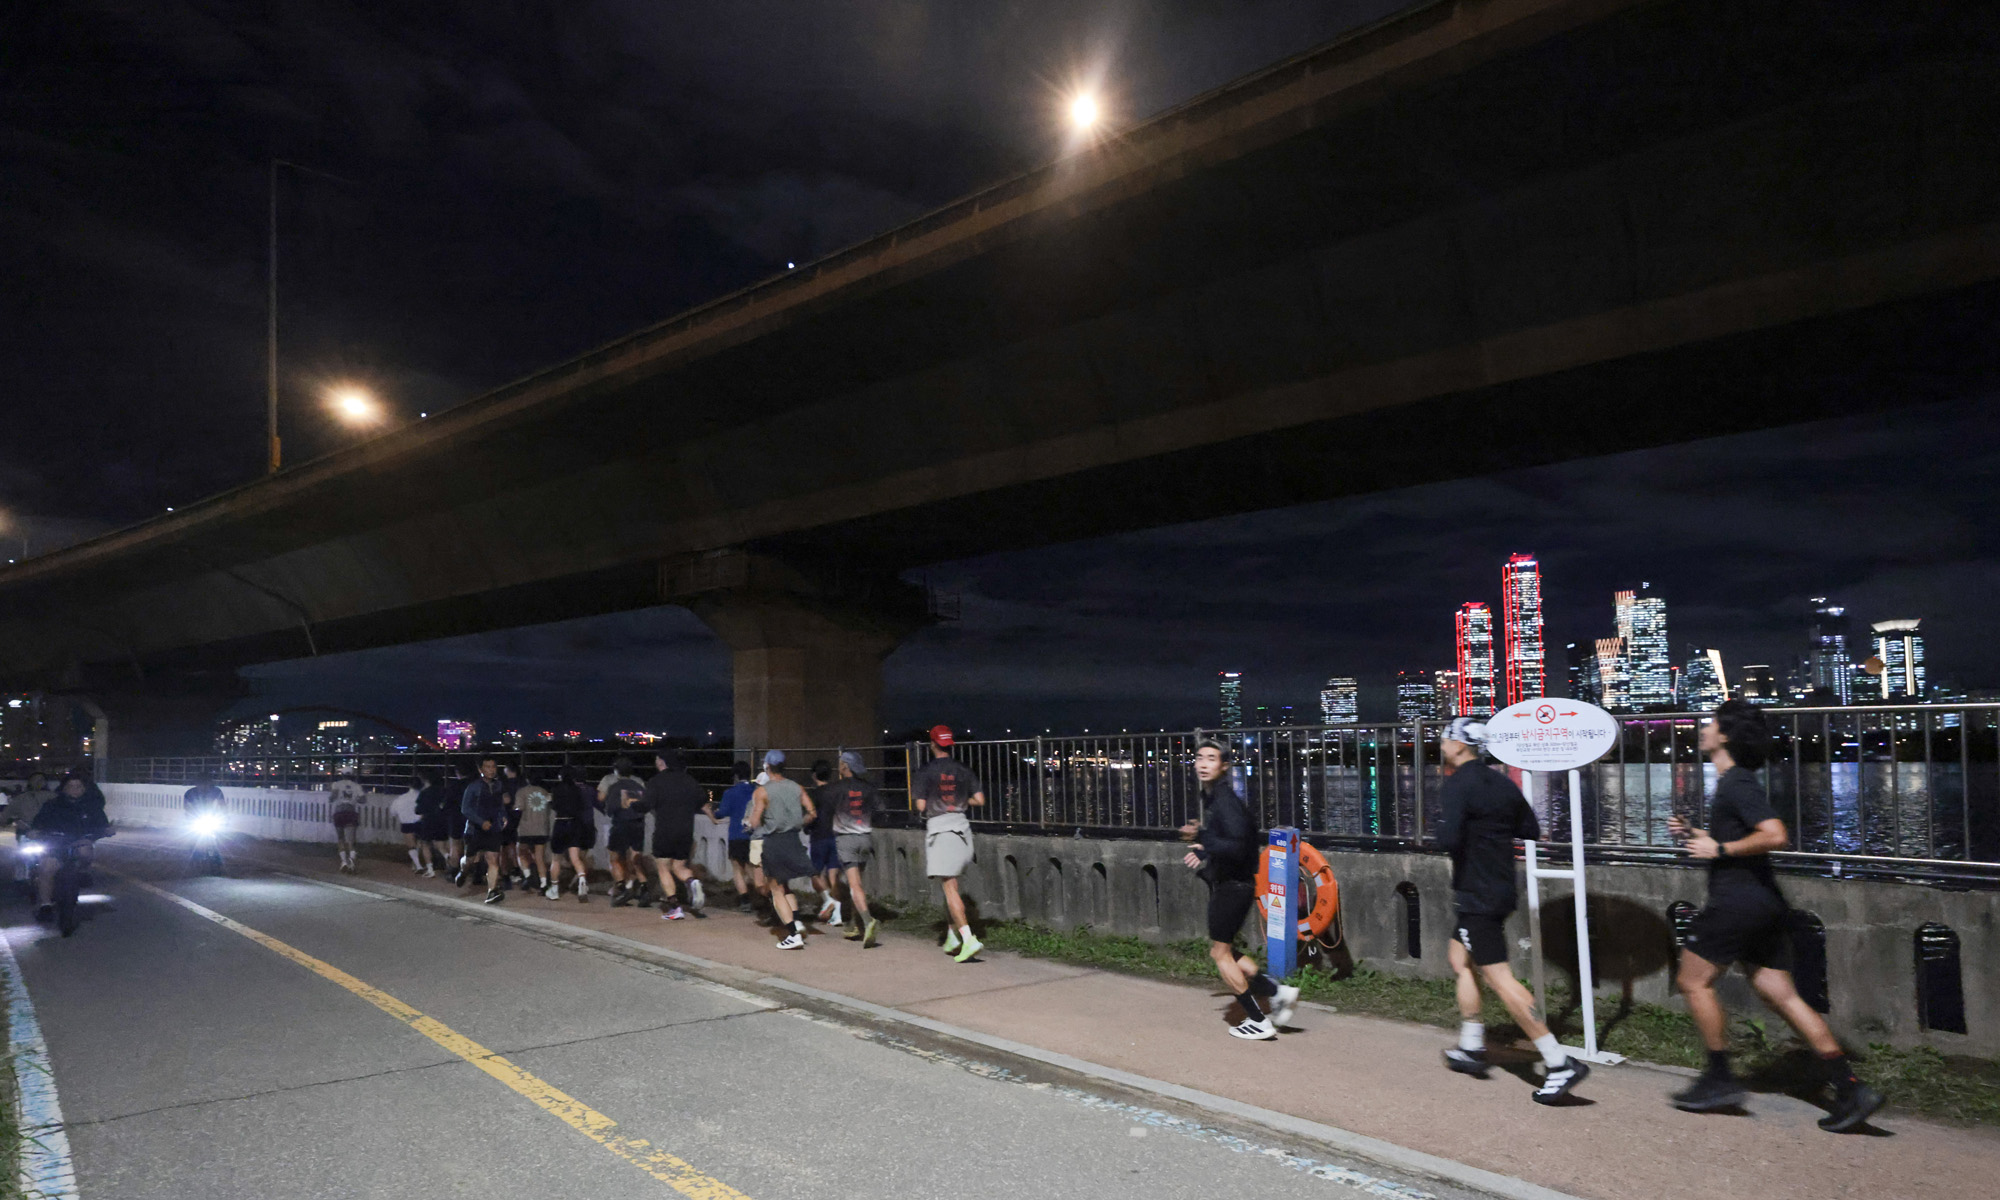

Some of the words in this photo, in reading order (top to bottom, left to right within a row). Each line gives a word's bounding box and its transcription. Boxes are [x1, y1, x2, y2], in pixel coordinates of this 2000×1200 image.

[1499, 732, 1519, 741] 지점부터
[1576, 729, 1606, 739] 시작됩니다
[1270, 884, 1284, 894] 위험
